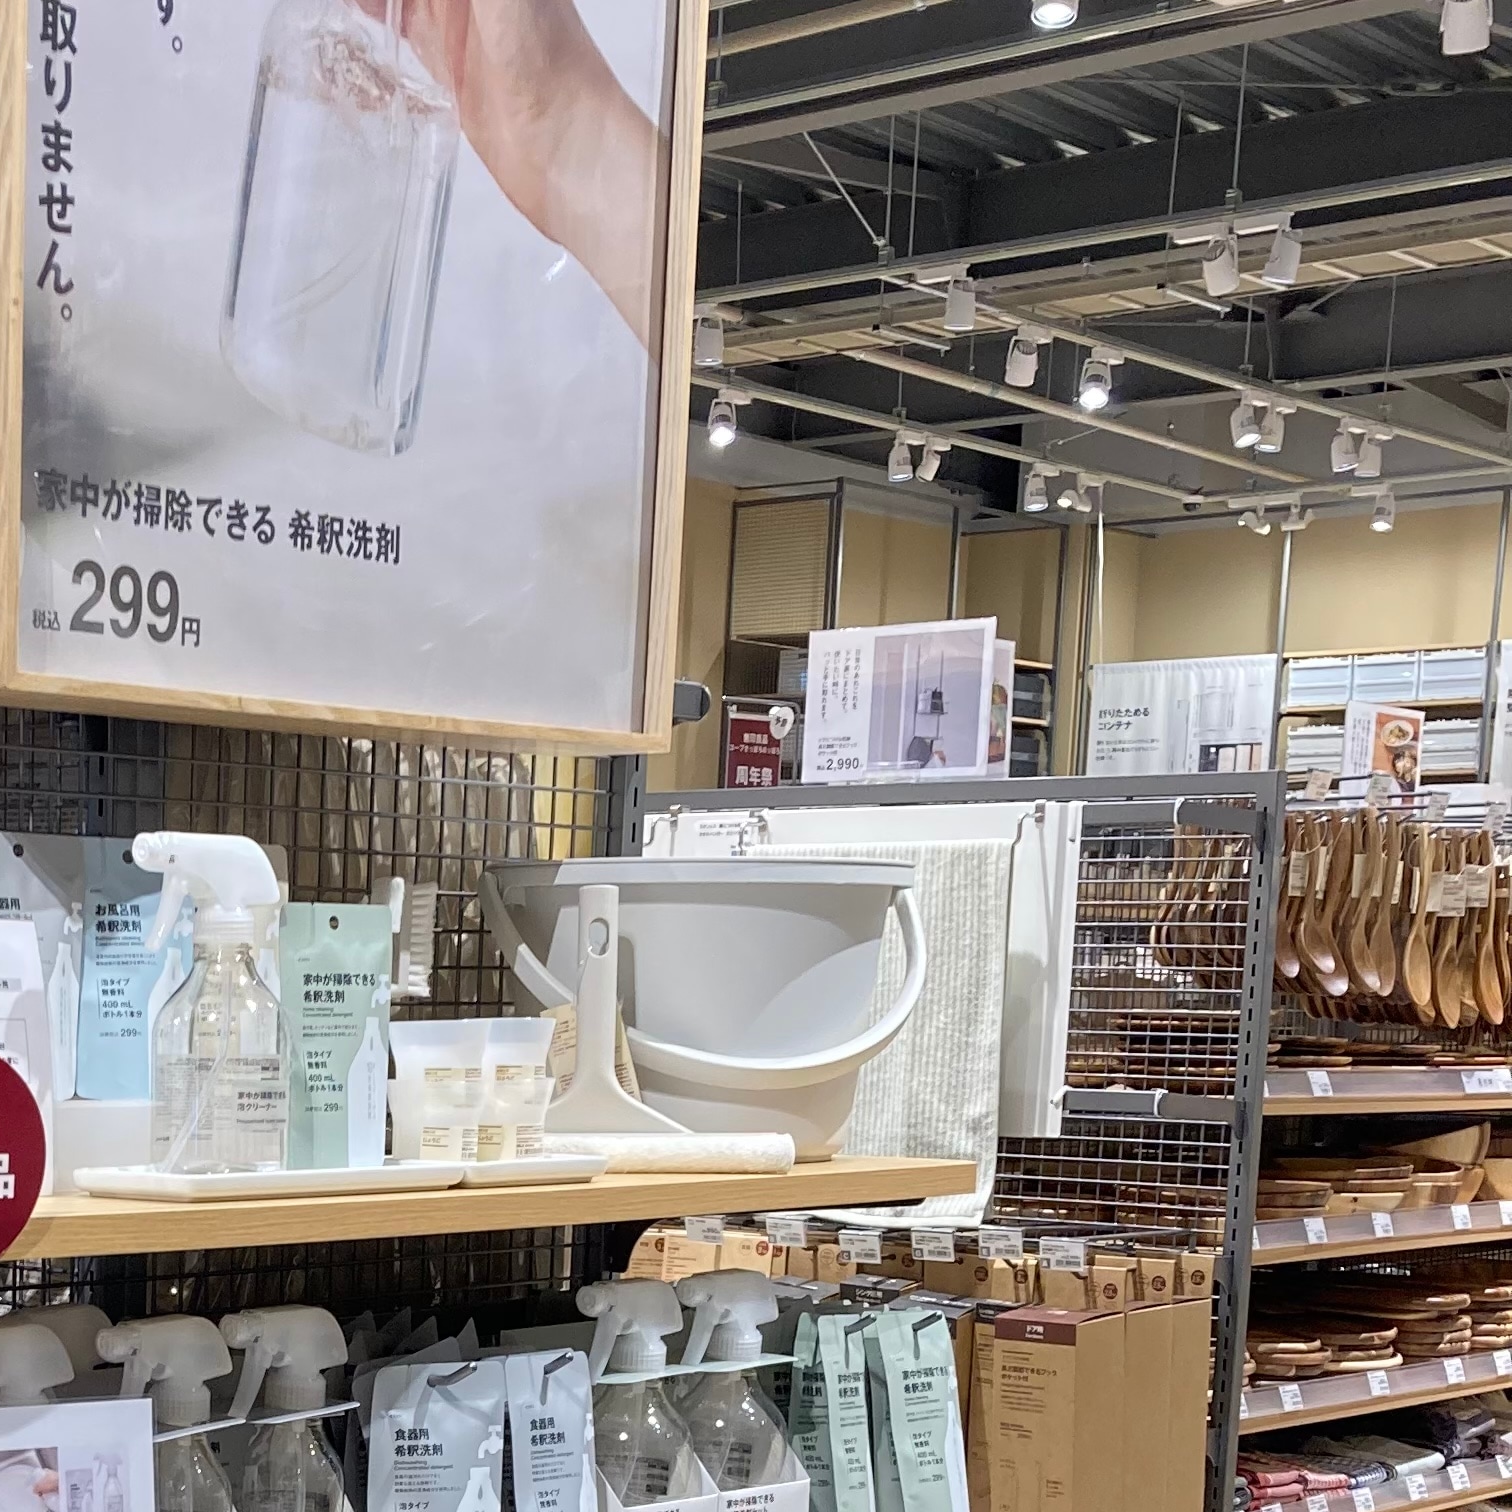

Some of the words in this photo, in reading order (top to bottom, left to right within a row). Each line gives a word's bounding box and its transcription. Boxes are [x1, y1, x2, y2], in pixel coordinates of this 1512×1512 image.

[37, 0, 77, 321] 取りません。
[37, 468, 276, 544] 家中が掃除できる
[288, 509, 401, 565] 希釈洗剤
[95, 904, 140, 917] お風呂用
[96, 920, 141, 933] 希釈洗剤
[303, 973, 375, 986] 家中が掃除できる
[303, 990, 345, 1003] 希釈洗剤
[530, 1417, 555, 1431] 食器用
[395, 1428, 429, 1440] 食器用
[530, 1432, 565, 1447] 希釈洗剤
[395, 1444, 443, 1456] 希釈洗剤
